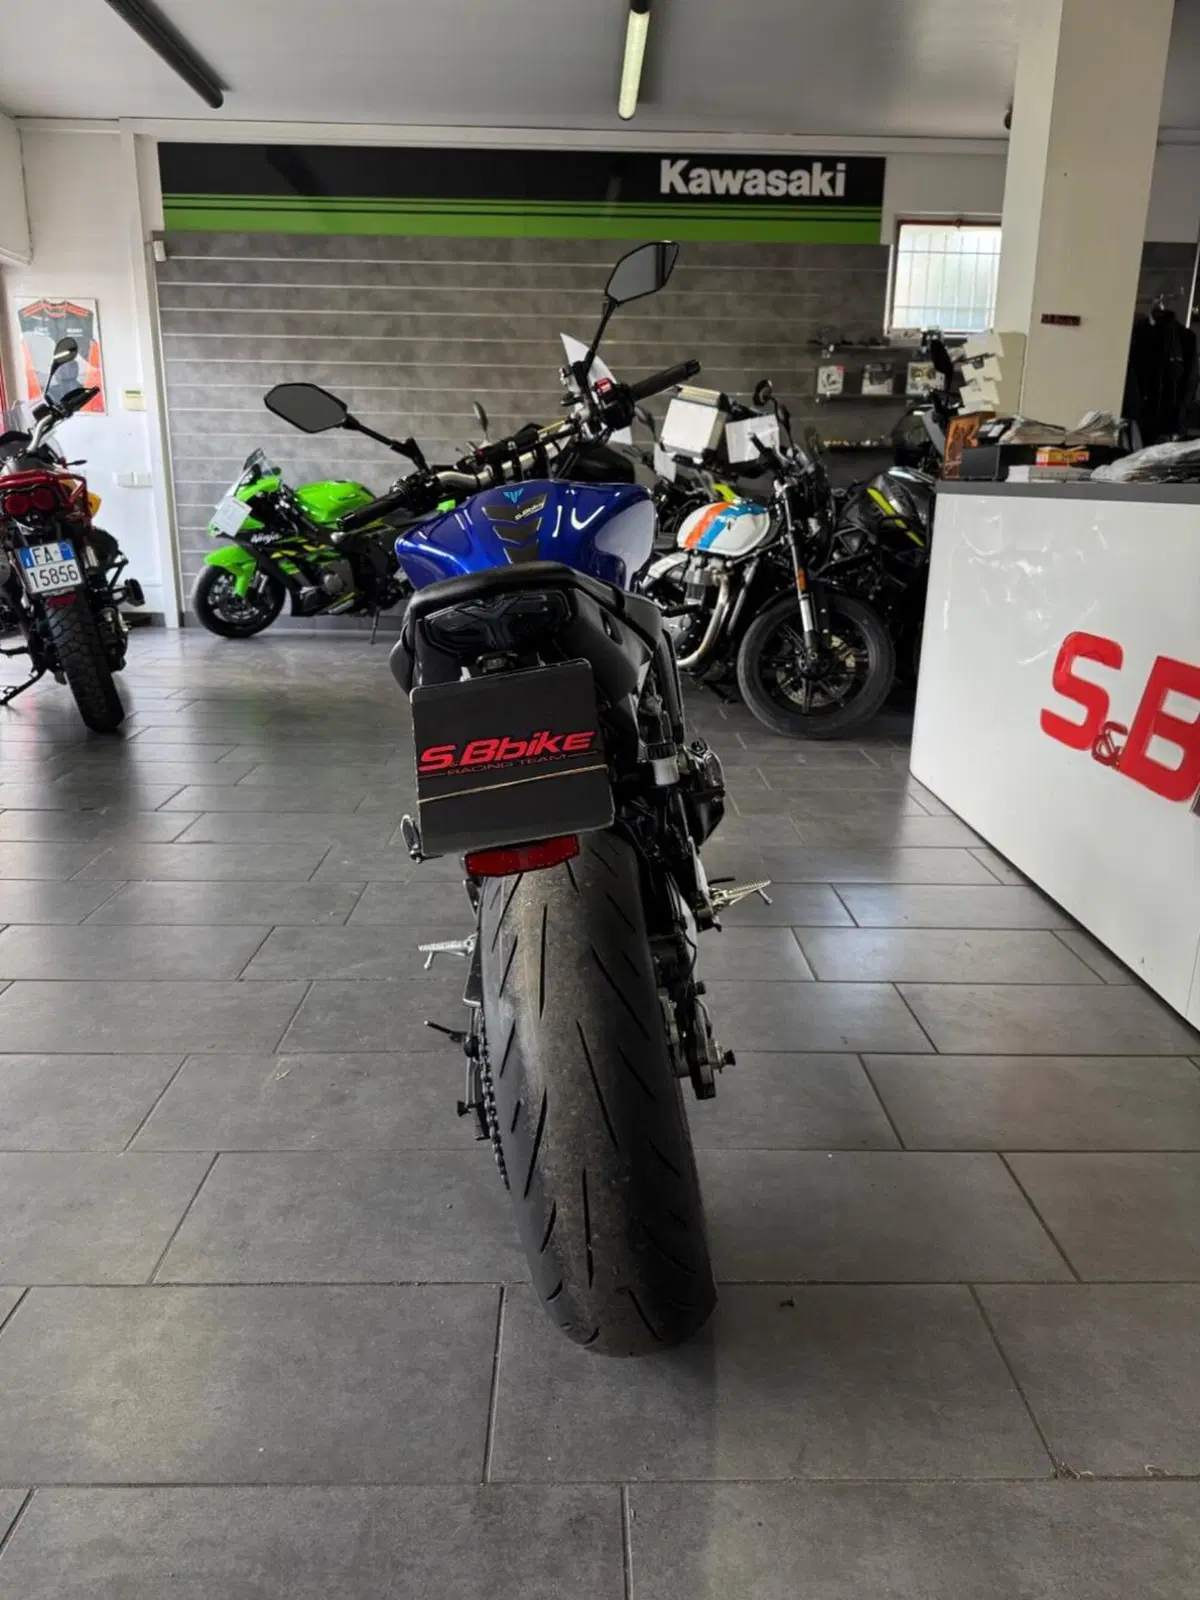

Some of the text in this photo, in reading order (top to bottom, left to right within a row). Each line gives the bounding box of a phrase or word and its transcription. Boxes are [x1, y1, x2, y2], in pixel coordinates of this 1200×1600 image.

[660, 159, 846, 197] Kawasaki
[251, 531, 282, 545] Ninja
[32, 546, 53, 564] FA
[30, 564, 79, 588] 15856
[447, 753, 566, 775] RACING TEAM
